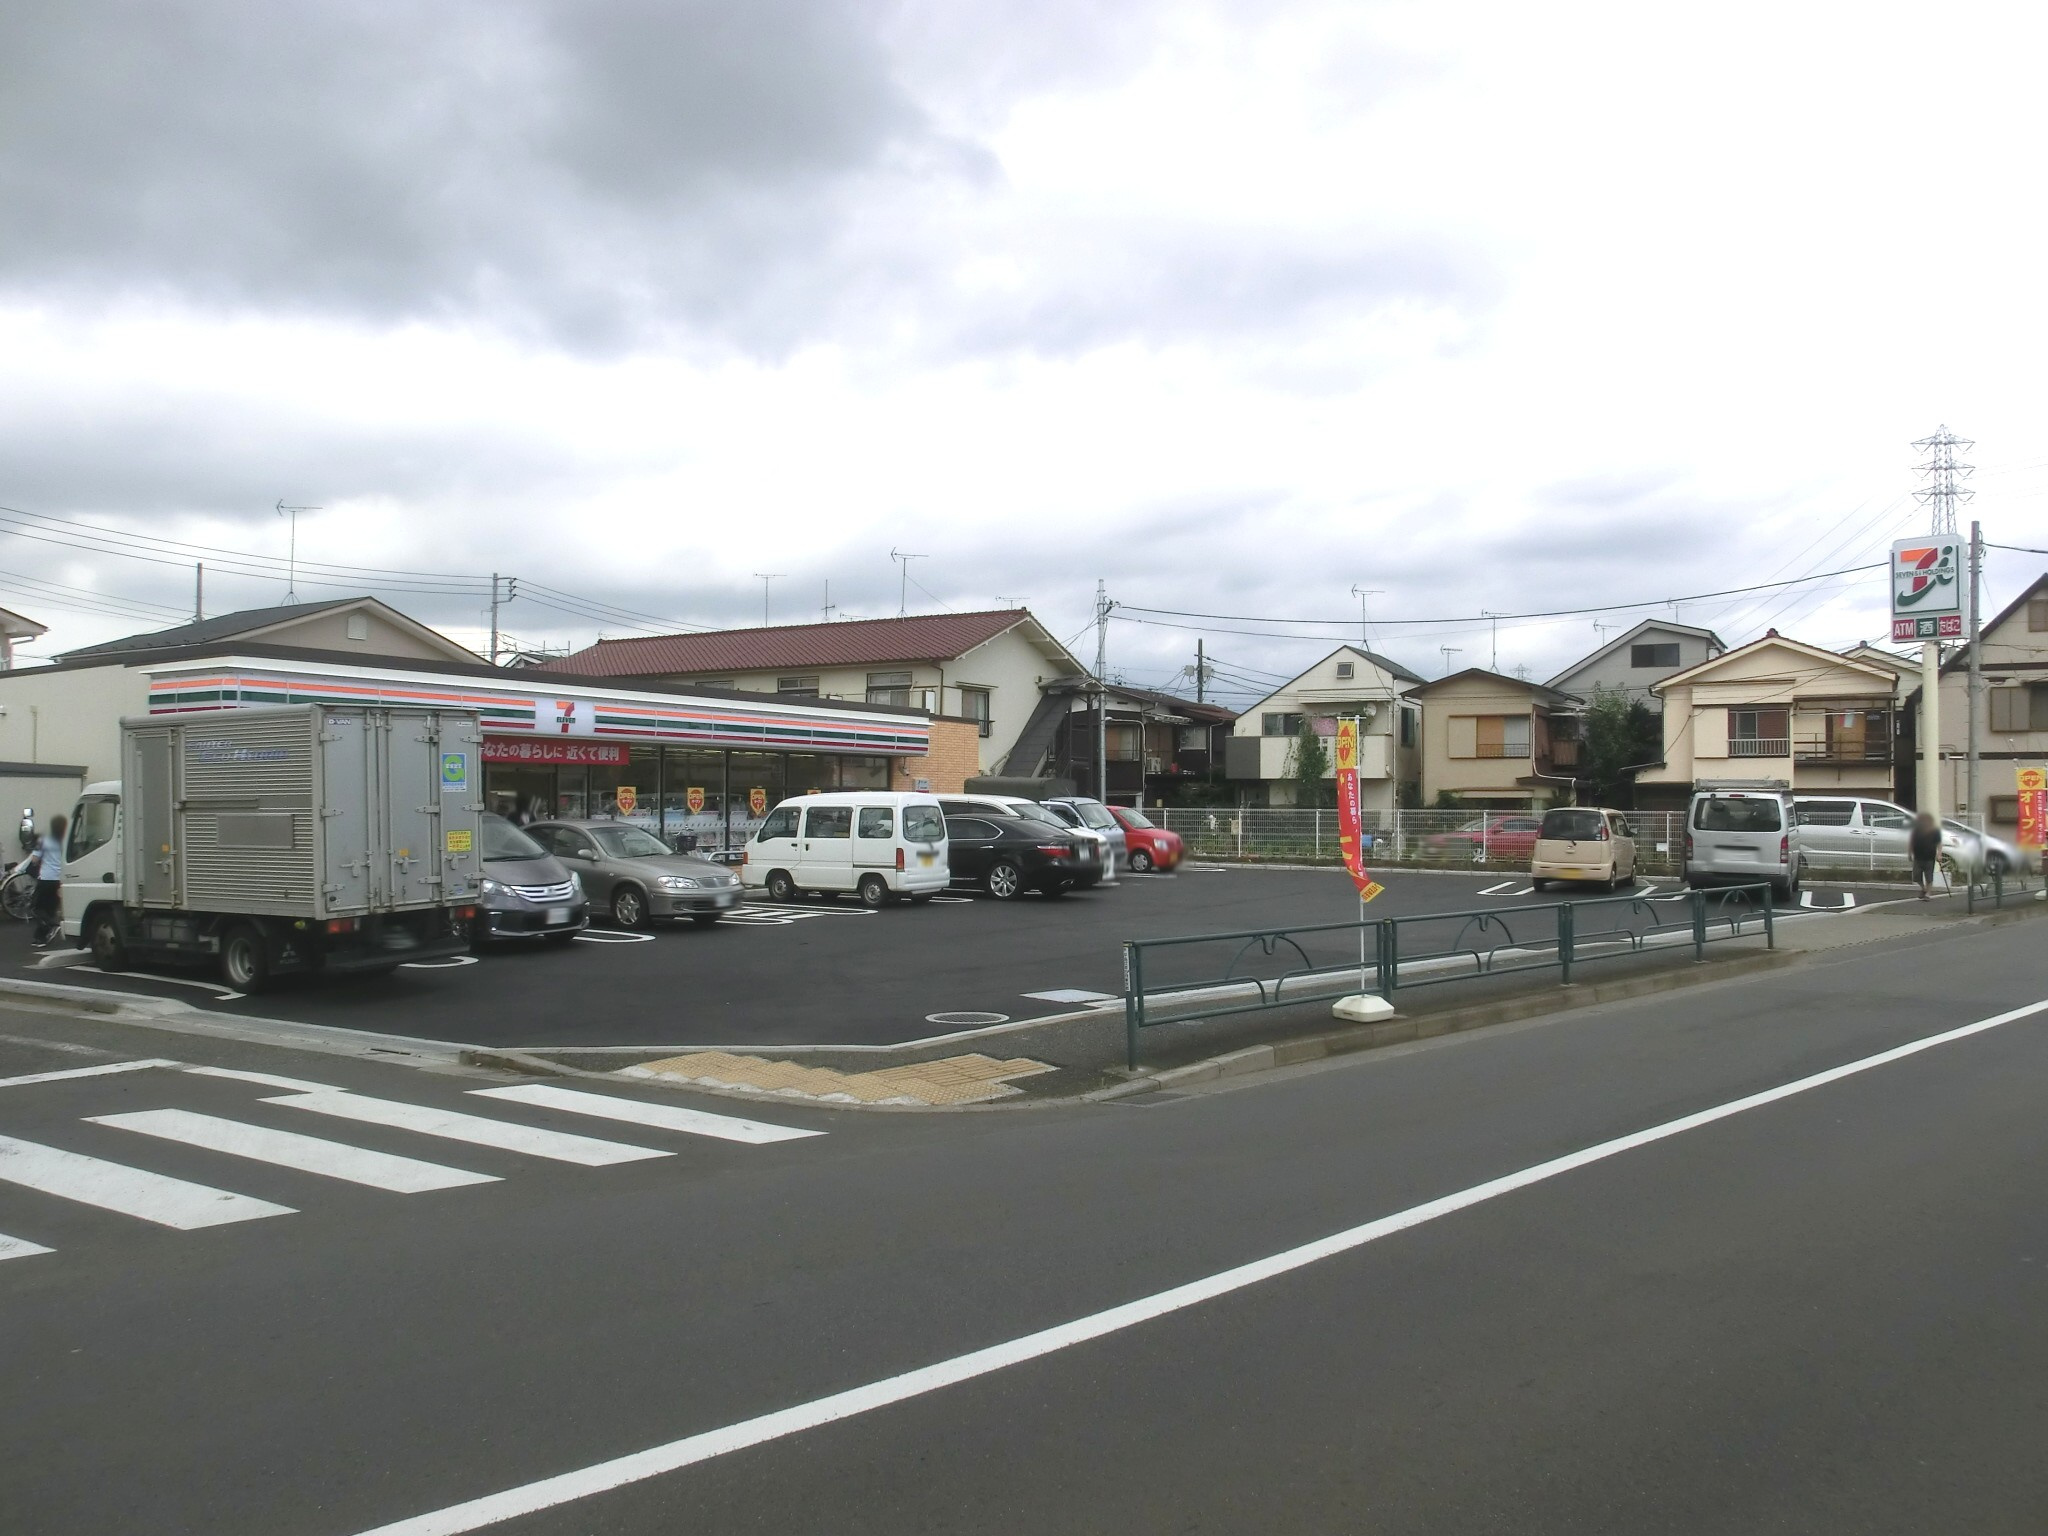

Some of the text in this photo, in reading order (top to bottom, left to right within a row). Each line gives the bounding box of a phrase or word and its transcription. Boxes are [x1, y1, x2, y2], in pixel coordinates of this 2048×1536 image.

[1922, 566, 1955, 576] HOLDINGS
[1894, 622, 1914, 637] ATM
[1919, 620, 1934, 635] 酒
[1939, 618, 1961, 633] たばこ
[556, 701, 576, 734] 7
[482, 741, 619, 761] なたの暮らしに 近くて便利
